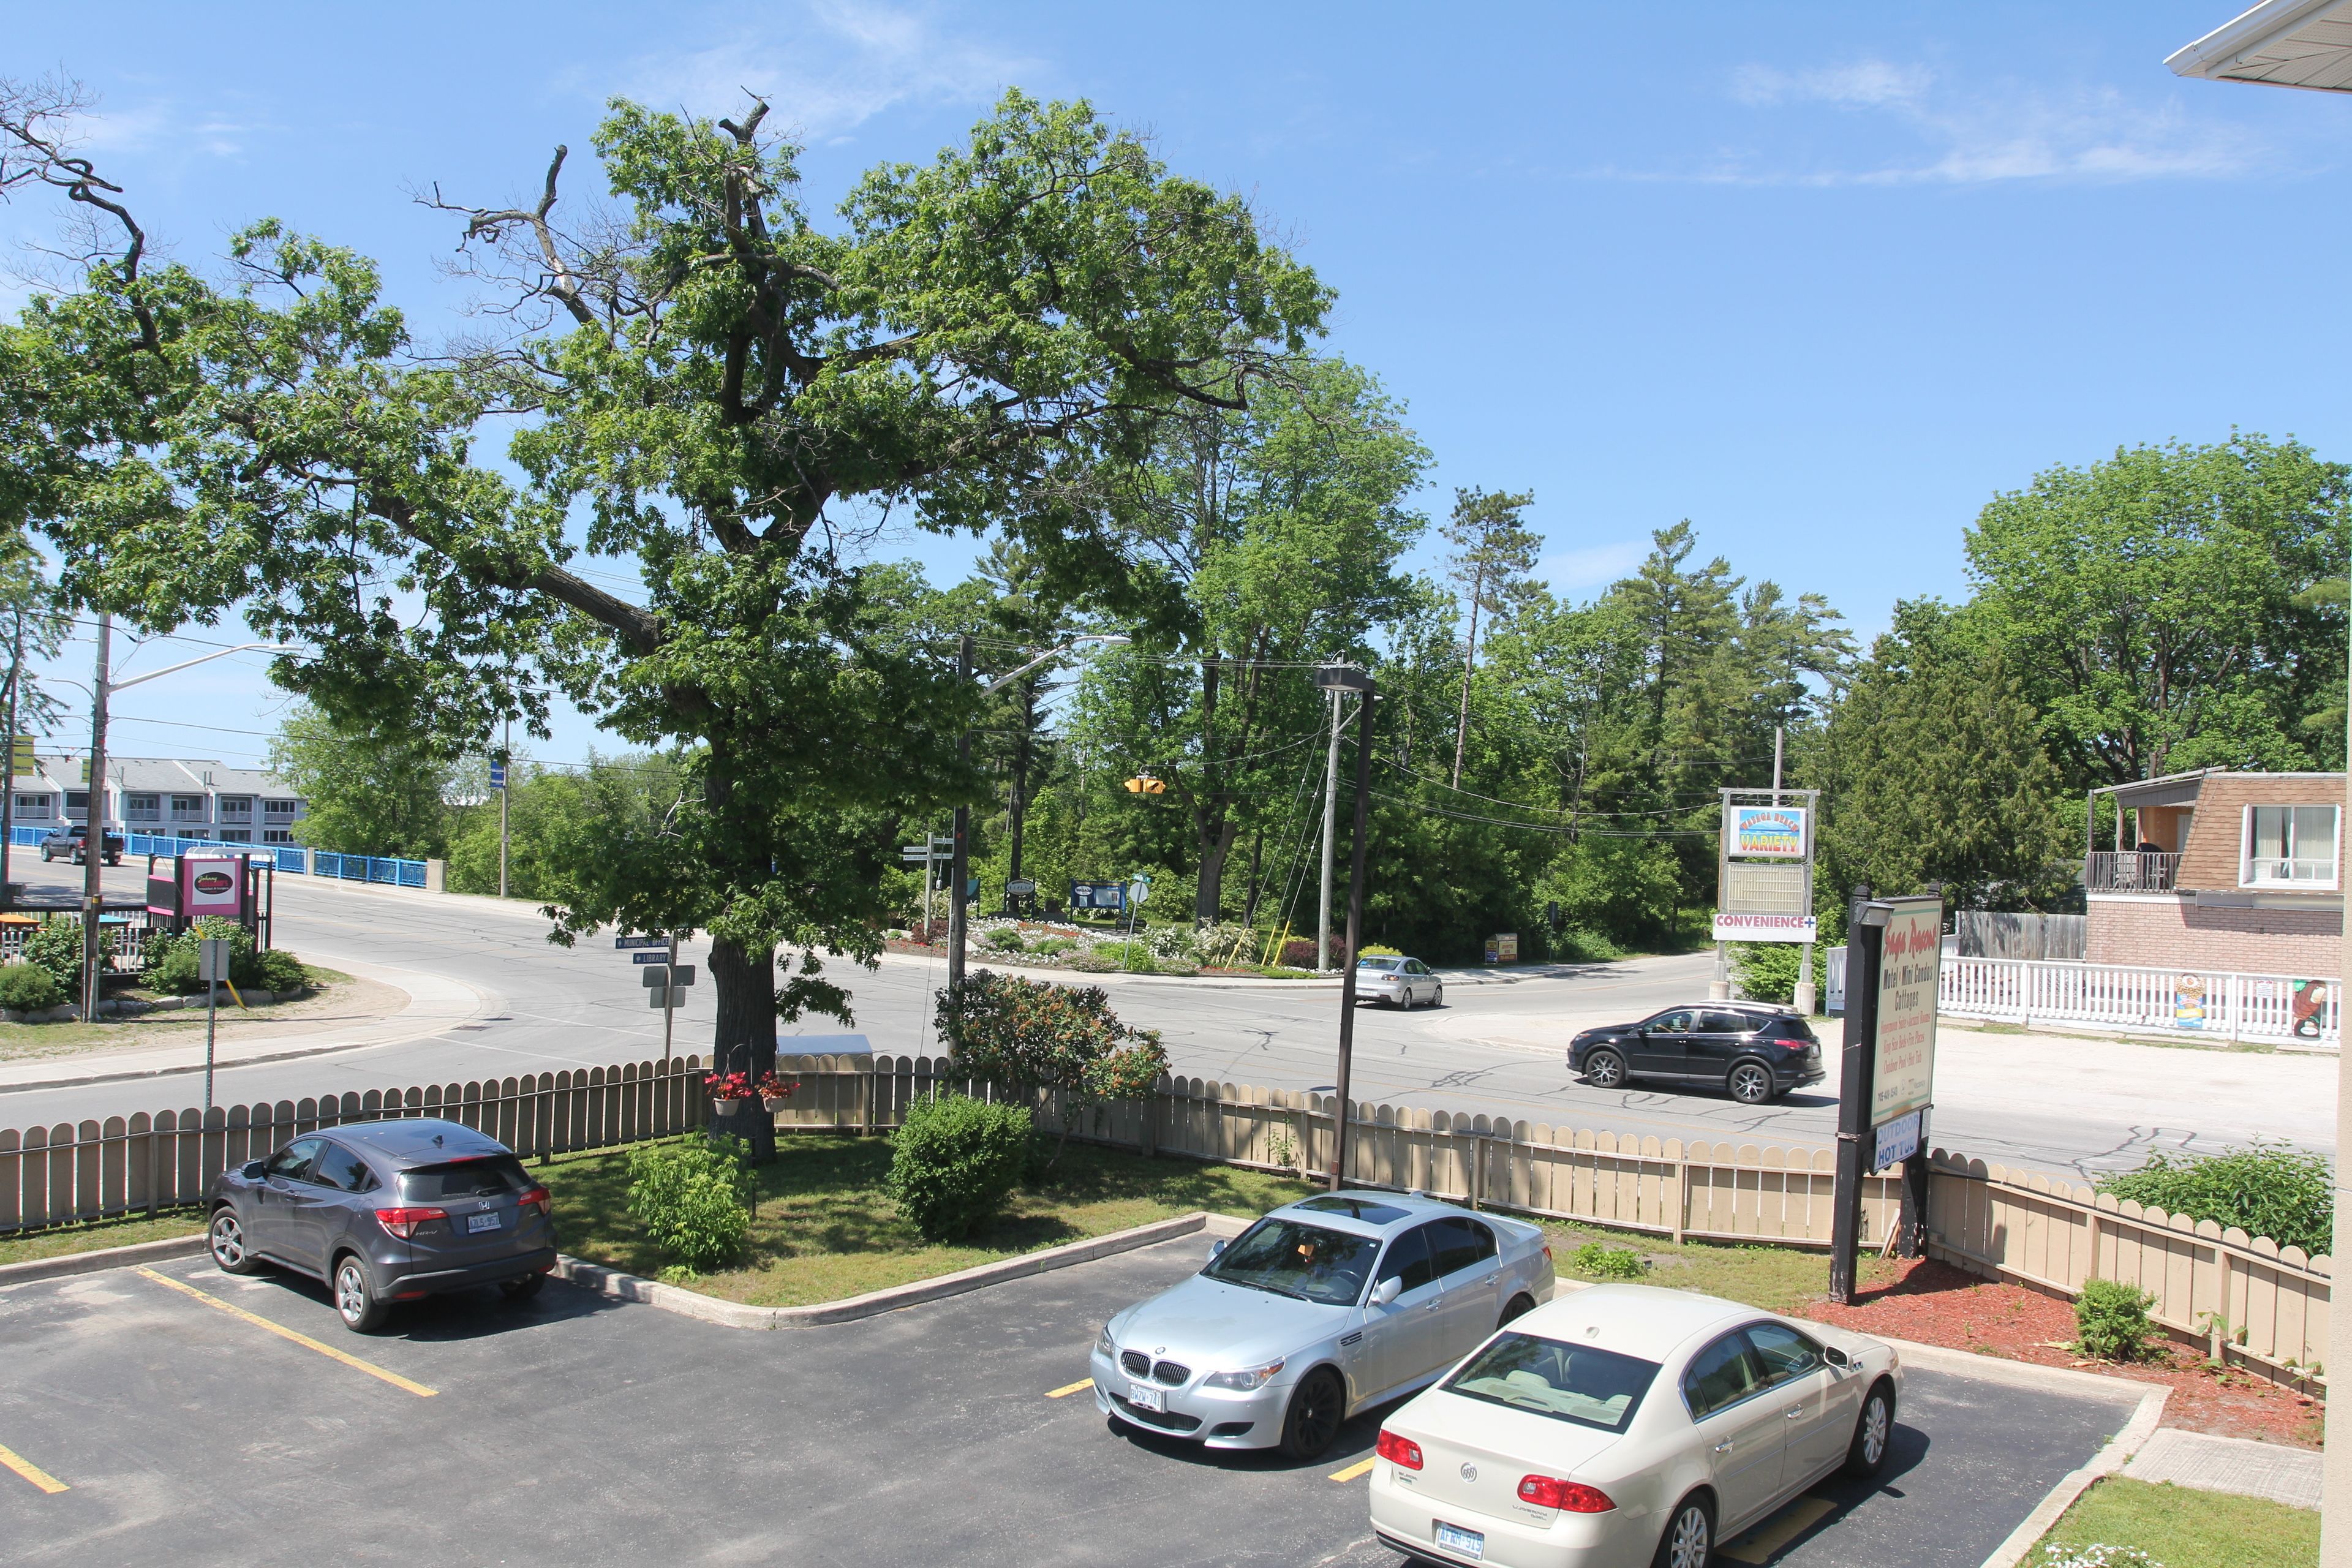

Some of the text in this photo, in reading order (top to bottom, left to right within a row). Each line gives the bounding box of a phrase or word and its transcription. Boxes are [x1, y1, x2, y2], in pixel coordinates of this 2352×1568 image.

[1741, 812, 1799, 832] WASAGA BEACH
[1740, 834, 1798, 852] VARIETY
[1883, 917, 1937, 963] Saga Resort
[1883, 962, 1933, 990] Motel Mini Condos
[1895, 989, 1919, 1011] Cottages
[1915, 1030, 1925, 1044] Places
[1884, 1058, 1898, 1074] Outdoor
[1878, 1114, 1918, 1145] OUTDOOR
[1879, 1137, 1915, 1166] HOT TUB
